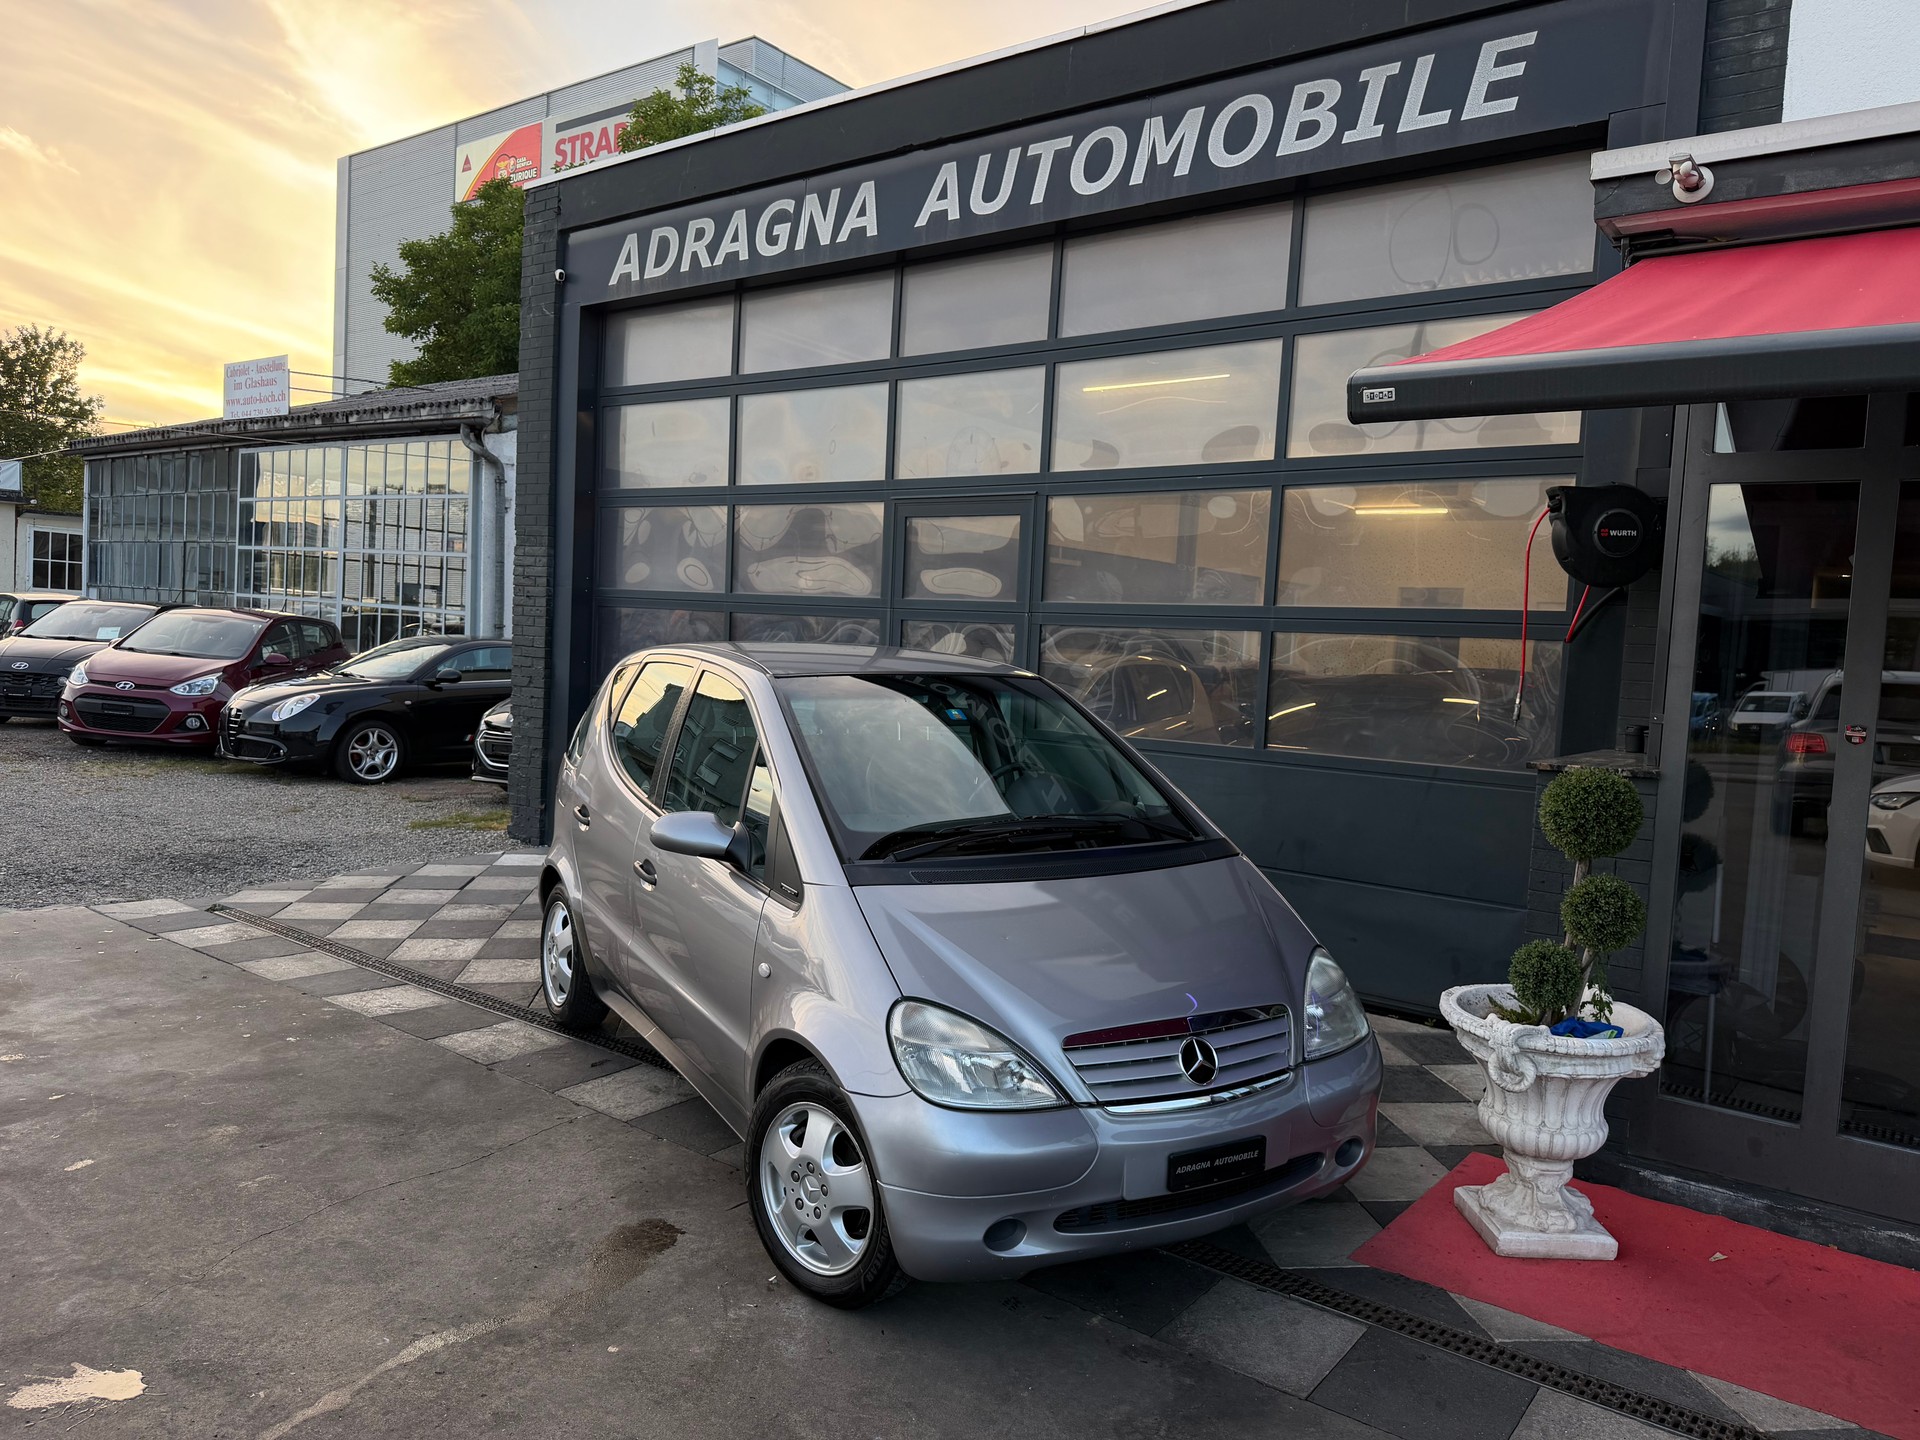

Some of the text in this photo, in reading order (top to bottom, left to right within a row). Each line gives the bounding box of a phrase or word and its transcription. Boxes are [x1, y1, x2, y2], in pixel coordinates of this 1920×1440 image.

[608, 31, 1538, 286] ADRAGNA AUTOMOBILE
[234, 376, 277, 390] im Glashaus
[226, 390, 286, 406] www.auto-koch.ch
[1175, 1149, 1259, 1175] ADRAGNA AUTOMOBILE
